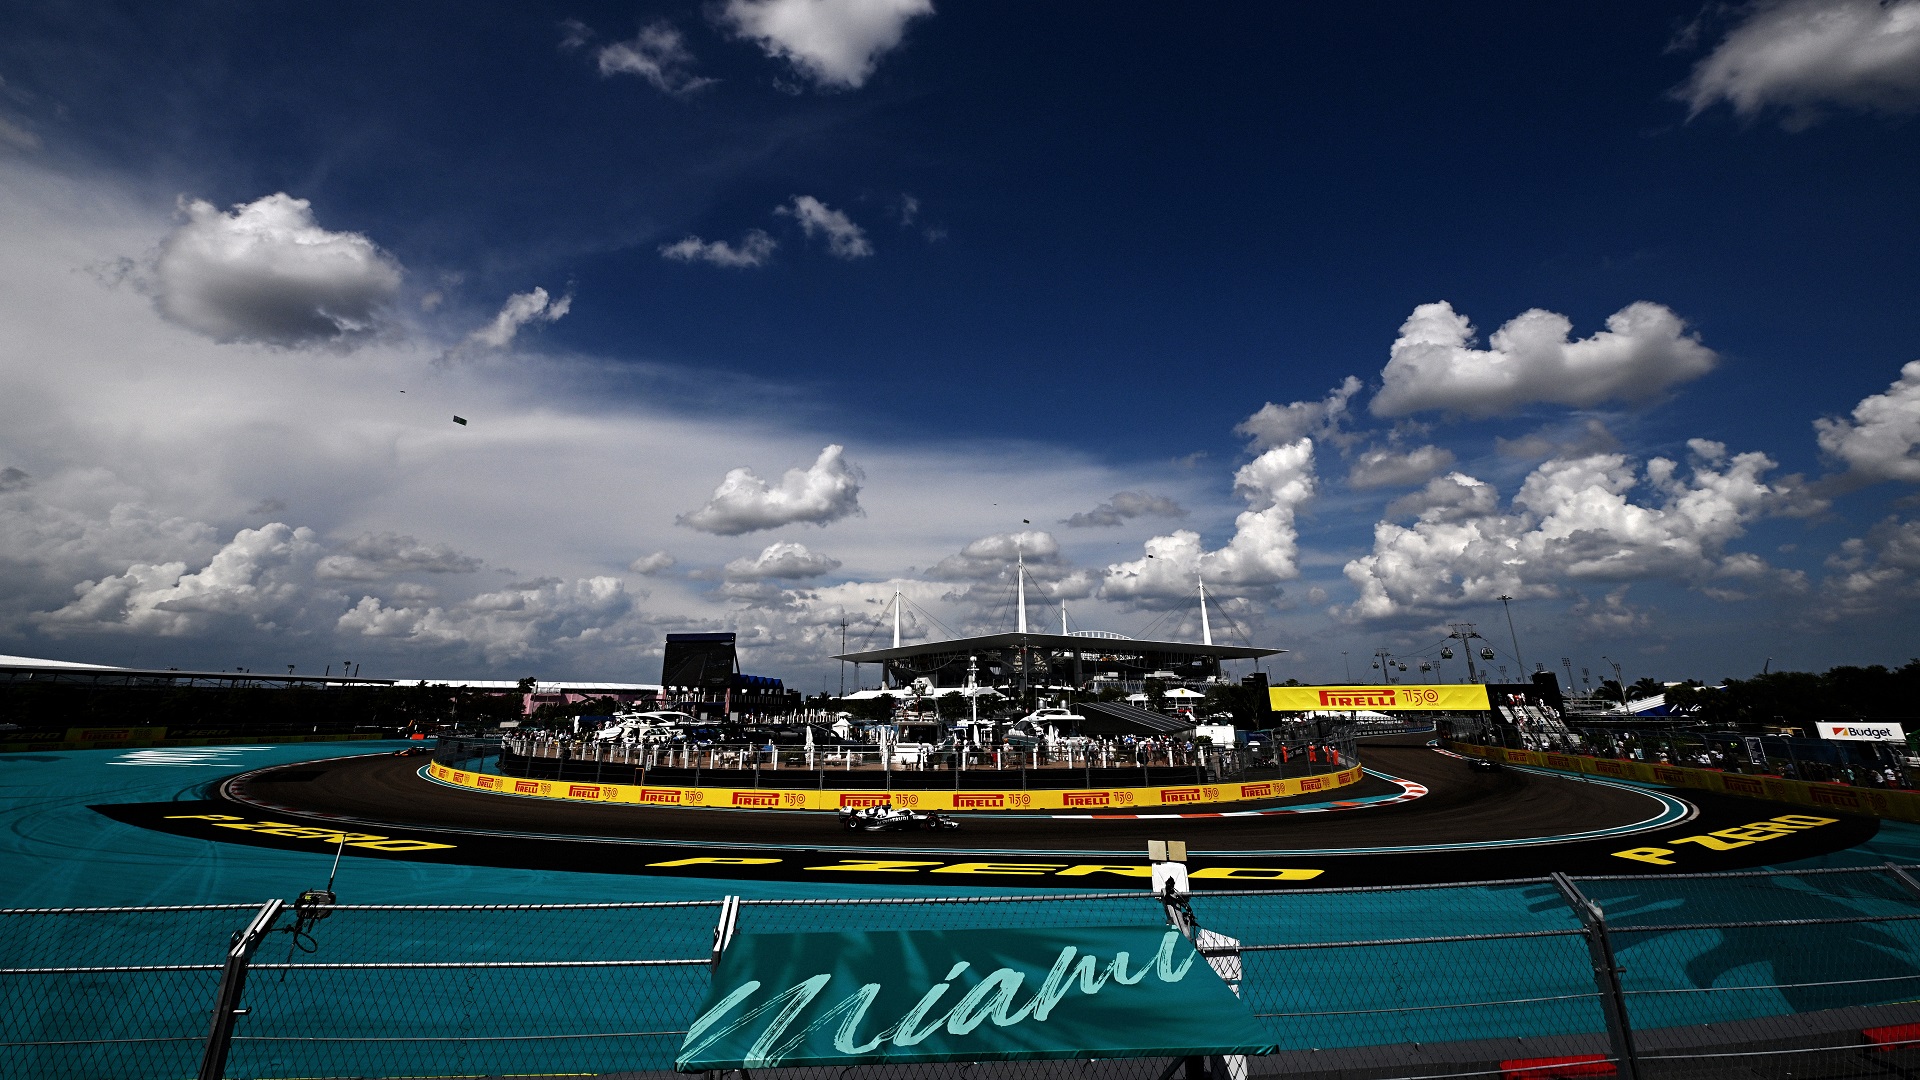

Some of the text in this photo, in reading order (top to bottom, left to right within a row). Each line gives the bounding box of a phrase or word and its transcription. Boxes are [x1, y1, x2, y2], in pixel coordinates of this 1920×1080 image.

[1318, 689, 1439, 706] PIRELLI 150
[1848, 727, 1893, 739] Budget
[515, 781, 539, 794] PIRELLI
[1241, 783, 1271, 797] PIRELLI
[1300, 778, 1322, 791] PIRELLI
[1722, 775, 1764, 795] PIRELLI
[568, 785, 600, 799] PIRELLI
[640, 789, 681, 803] PIRELLI
[1063, 792, 1110, 806] PIRELLI
[1160, 788, 1200, 802] PIRELLI
[1808, 786, 1860, 807] PIRELLI
[732, 792, 806, 807] PIRELLI 150
[896, 794, 919, 807] 150
[953, 793, 1031, 807] PIRELLI 150
[211, 821, 457, 852] ZERO
[1610, 814, 1840, 865] P ZERO
[644, 857, 1325, 881] P ZERO
[676, 925, 1198, 1068] Miami
